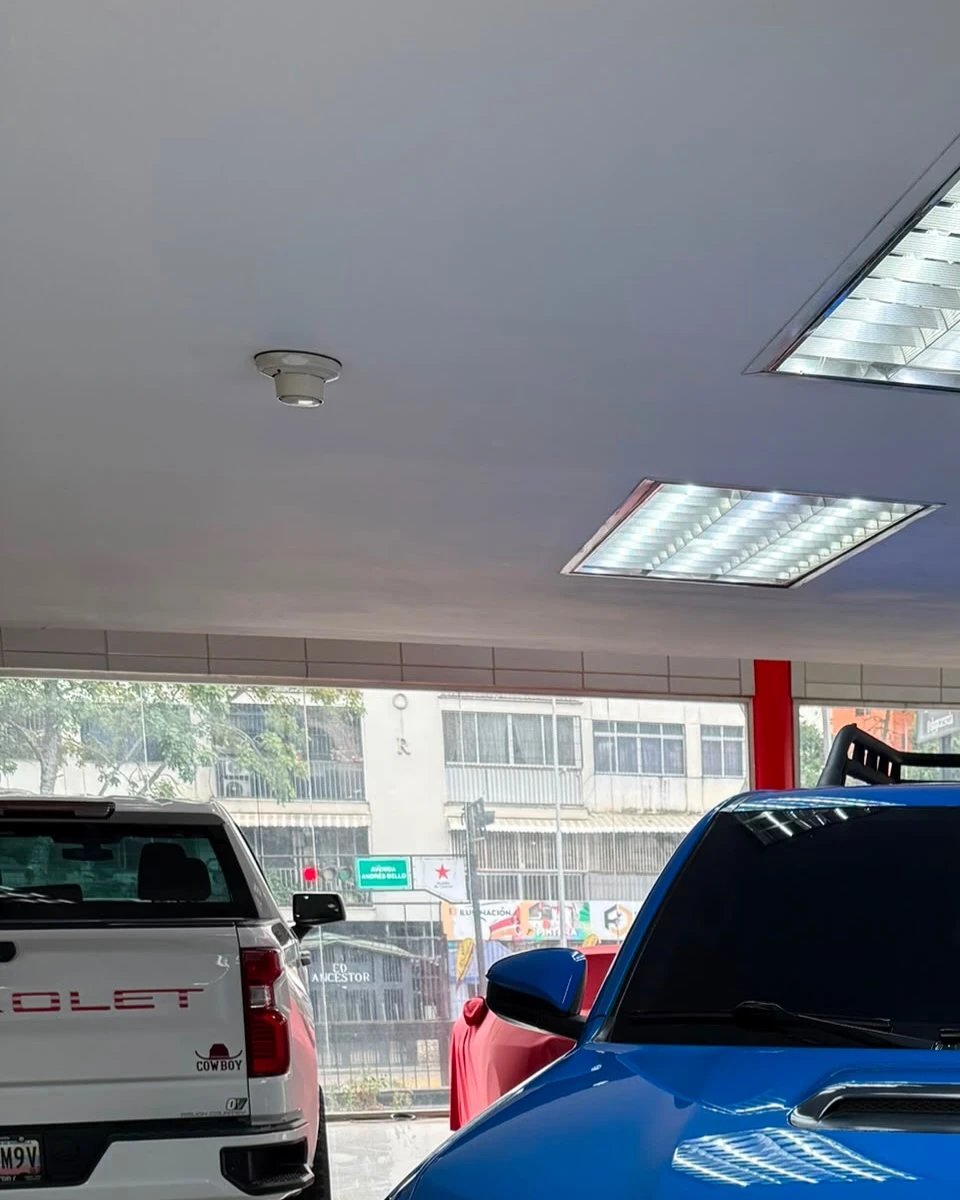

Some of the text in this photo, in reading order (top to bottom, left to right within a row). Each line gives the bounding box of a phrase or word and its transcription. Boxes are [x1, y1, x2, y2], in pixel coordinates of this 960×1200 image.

[311, 972, 370, 983] ANCESTOR
[0, 988, 204, 1012] OLET
[196, 1060, 242, 1072] COWBOY
